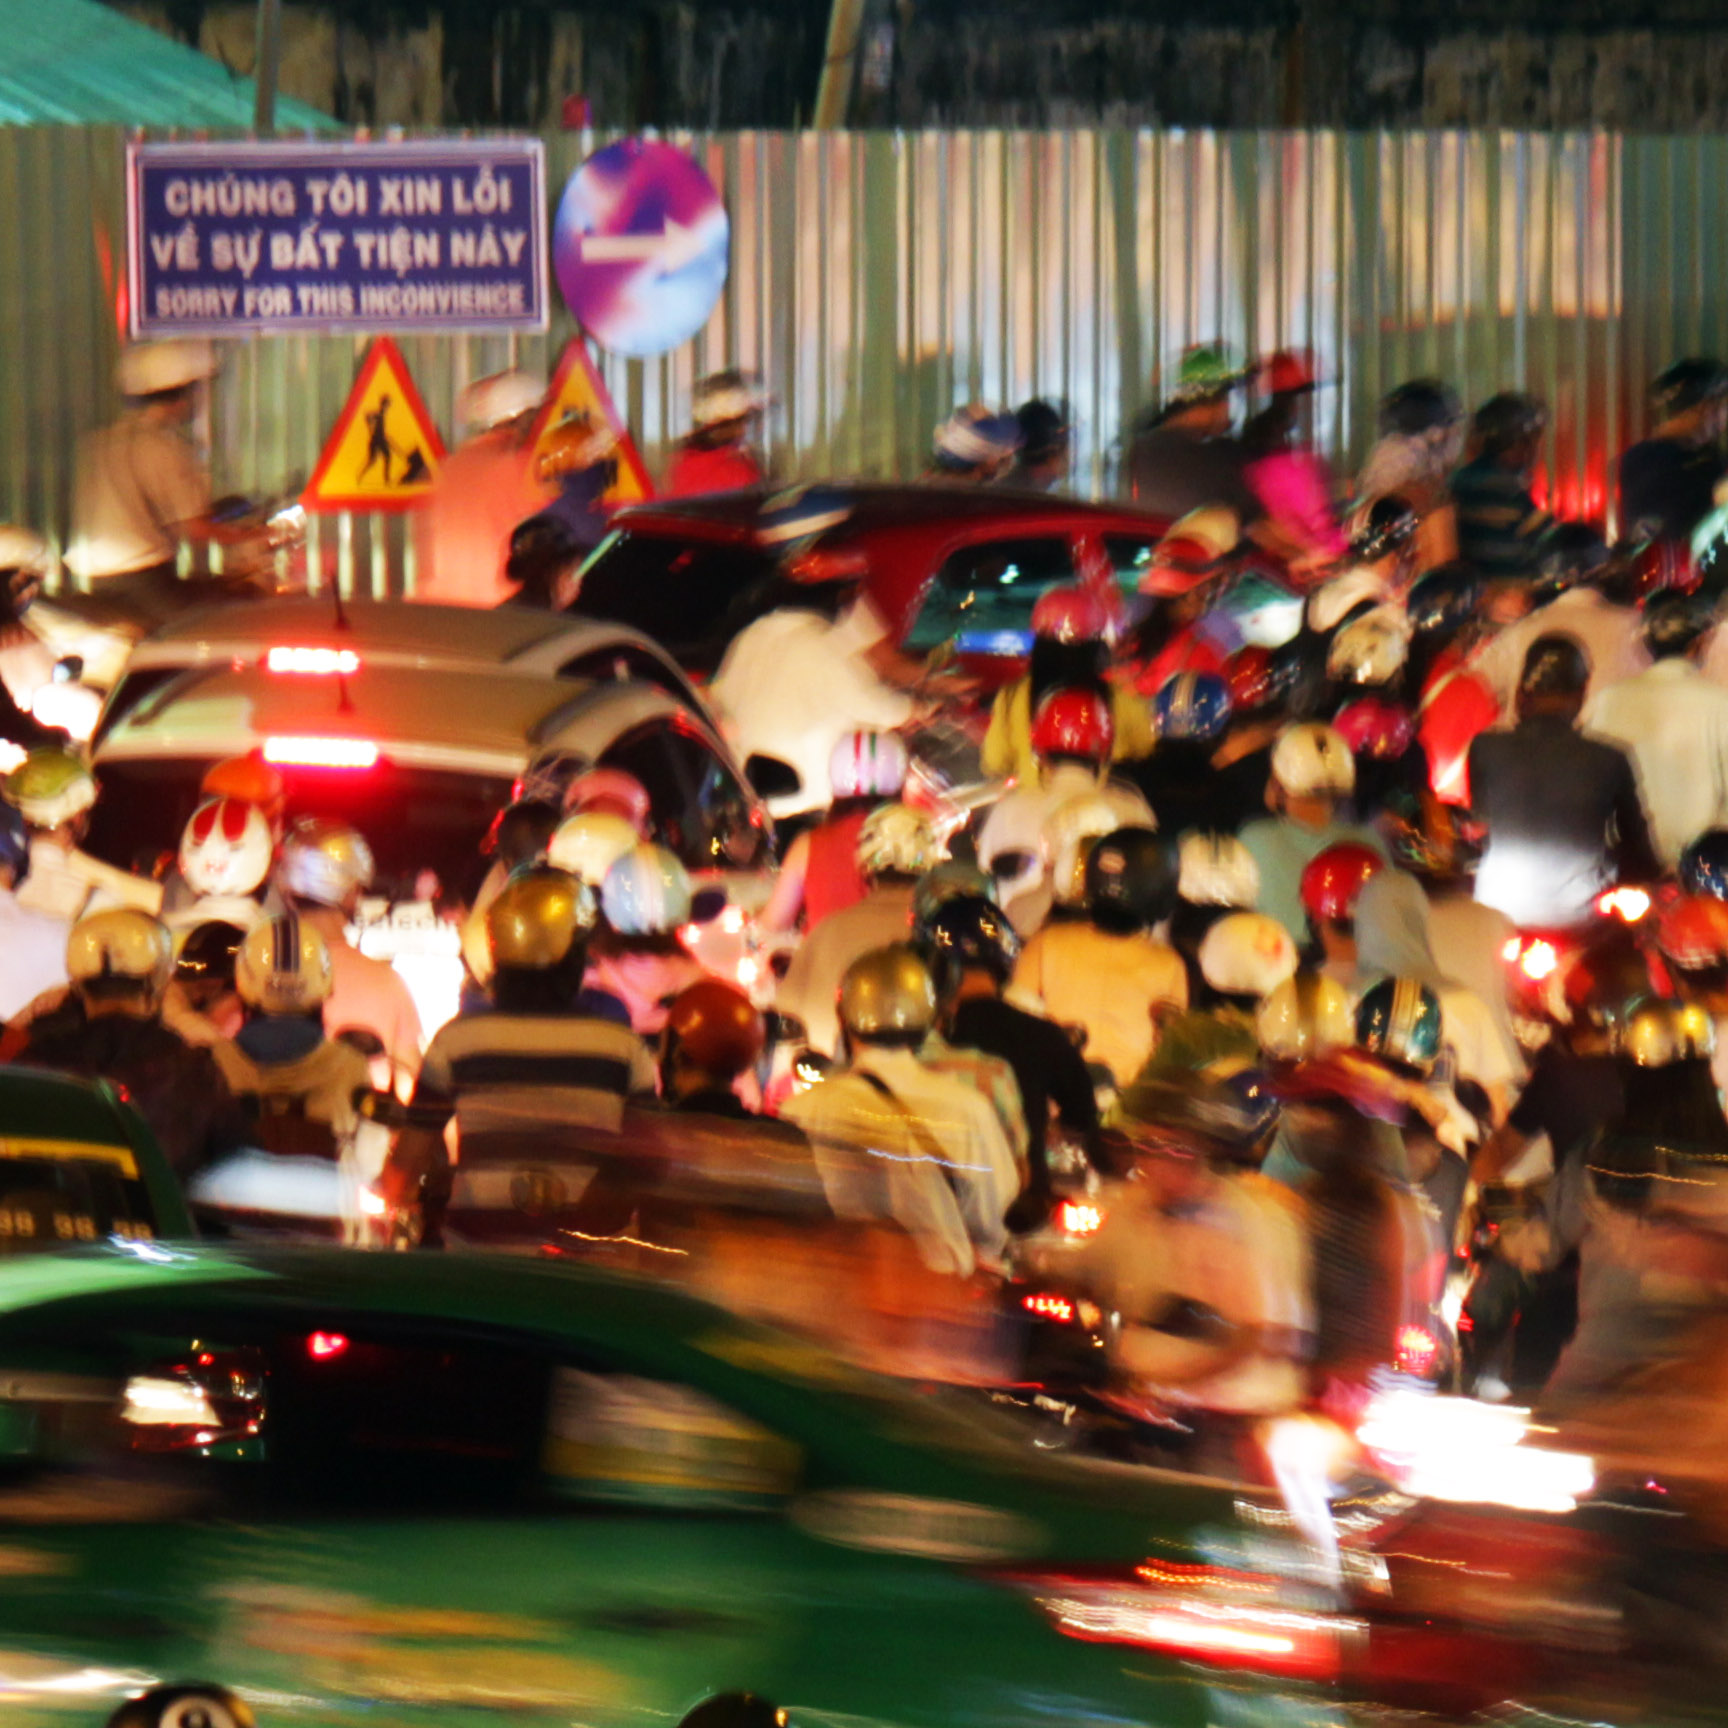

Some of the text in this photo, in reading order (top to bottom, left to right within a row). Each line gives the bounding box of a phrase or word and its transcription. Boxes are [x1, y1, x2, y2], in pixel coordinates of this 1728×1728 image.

[165, 163, 511, 217] CHÚNG TÔI XIN LỖI
[150, 220, 200, 270] VỀ
[270, 218, 344, 270] BẤT
[352, 223, 441, 279] TIỆN
[155, 284, 238, 318] SORRY
[243, 283, 293, 318] FOR
[296, 282, 355, 317] THIS
